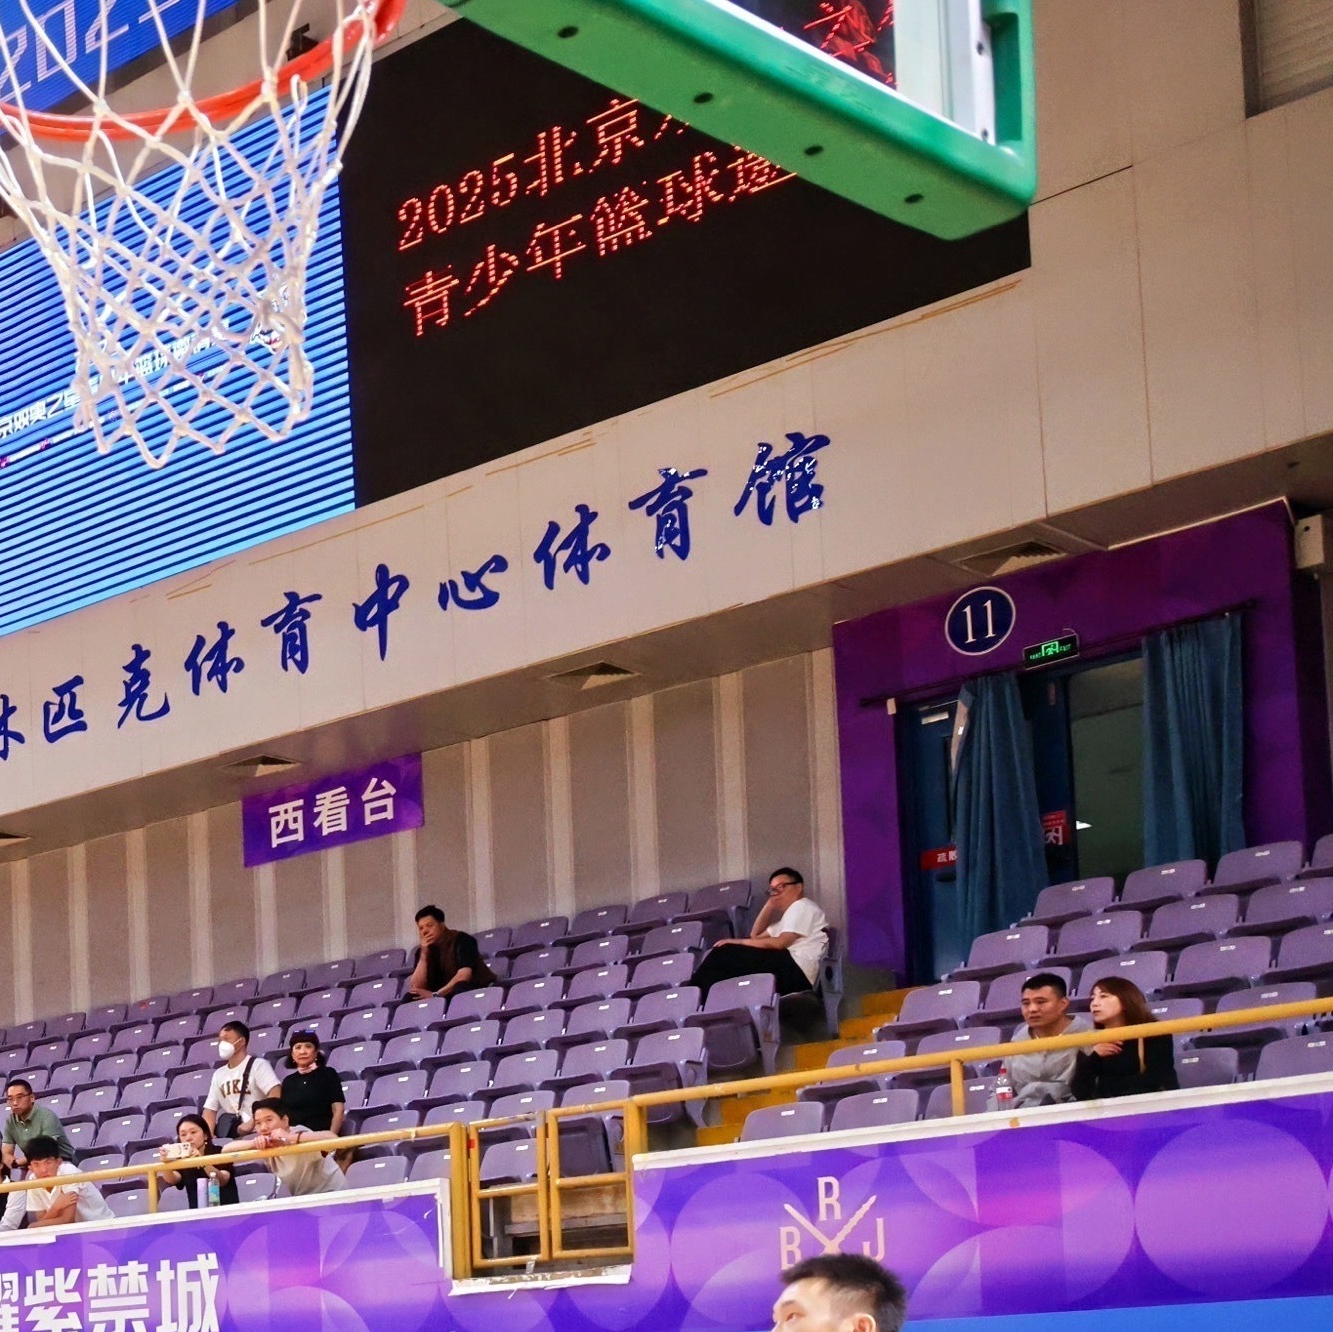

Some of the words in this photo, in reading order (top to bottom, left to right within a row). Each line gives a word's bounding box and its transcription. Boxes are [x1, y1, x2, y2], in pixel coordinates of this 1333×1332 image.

[399, 98, 689, 250] 2025北京
[962, 599, 997, 645] 11
[267, 777, 397, 849] 西看台
